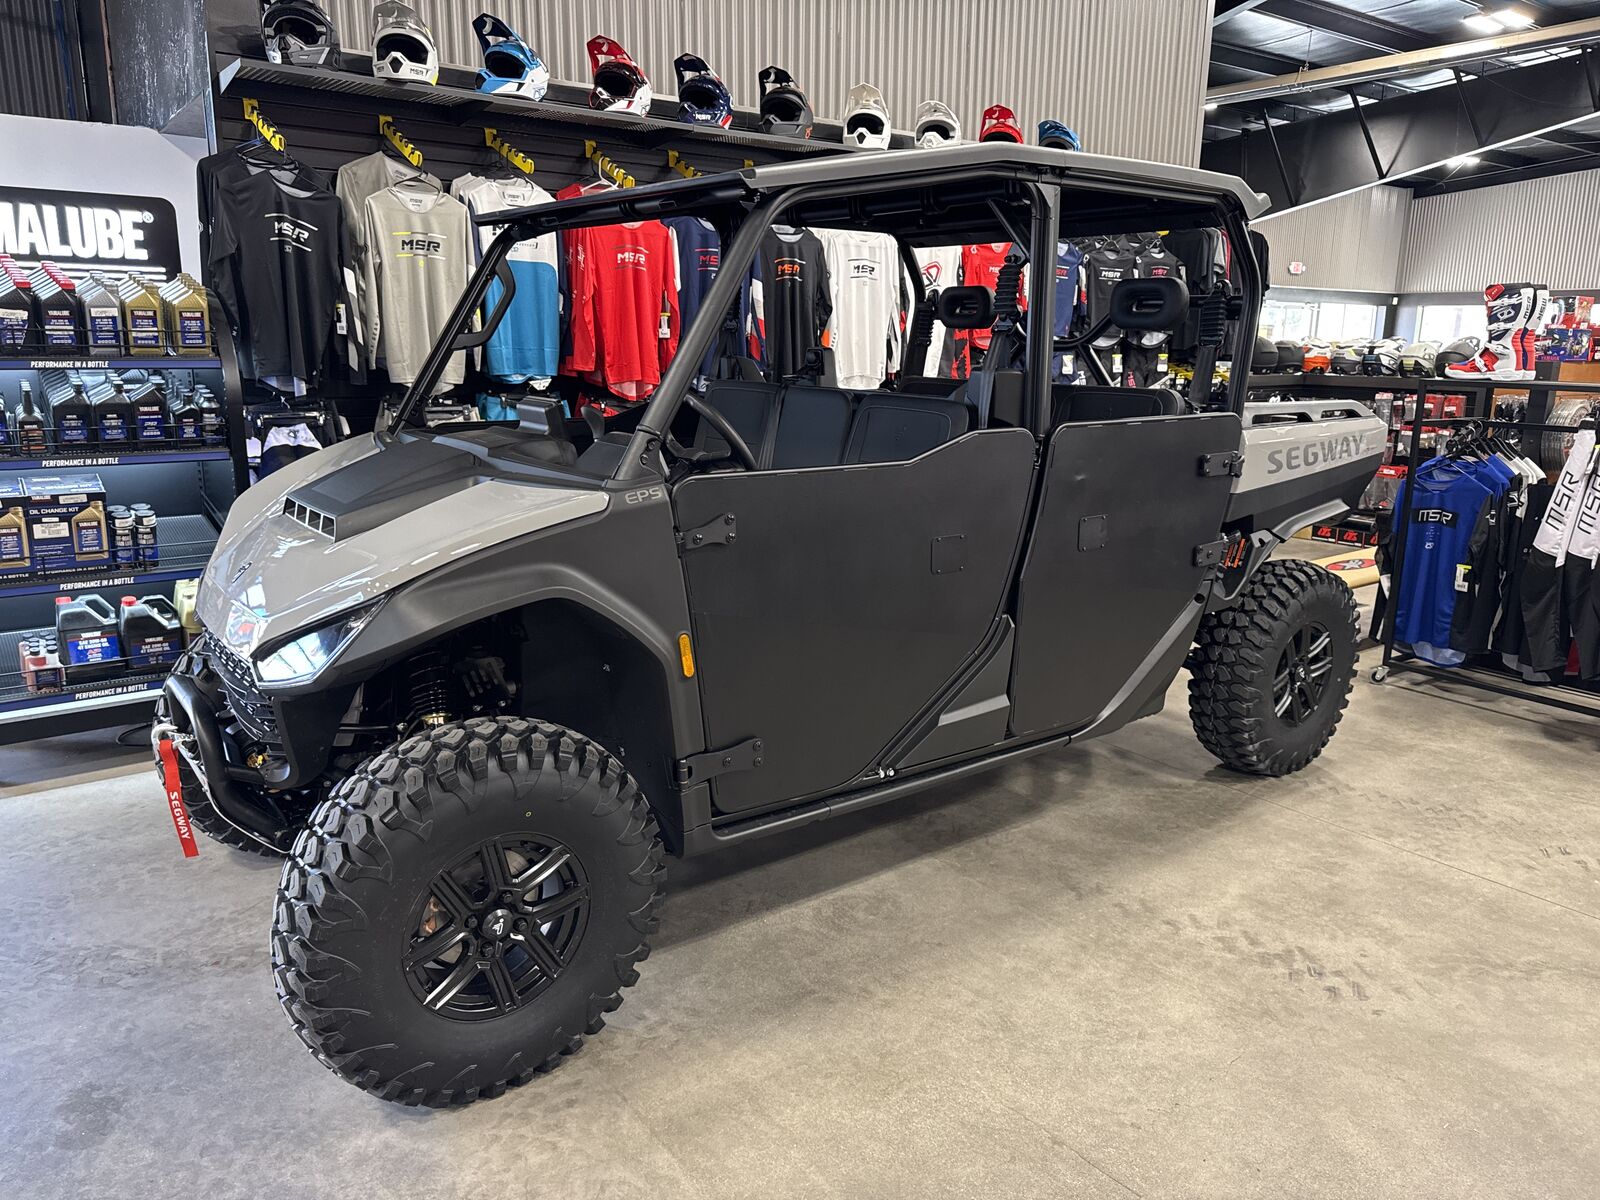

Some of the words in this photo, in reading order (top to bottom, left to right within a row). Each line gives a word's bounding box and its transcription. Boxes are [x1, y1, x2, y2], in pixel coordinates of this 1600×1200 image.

[410, 68, 424, 76] MSR
[274, 222, 309, 242] MSR
[401, 240, 440, 252] MSR
[617, 252, 647, 265] MSR
[700, 256, 718, 264] MS
[778, 264, 800, 274] MSR
[853, 264, 875, 275] MSR
[1523, 296, 1532, 319] MSR
[1537, 298, 1547, 321] MSR
[1268, 434, 1364, 474] SEGWAY
[42, 459, 84, 467] PERFORMANCE
[625, 487, 662, 504] EPS
[1545, 471, 1579, 530] MSR
[1418, 509, 1452, 524] MSR
[60, 581, 100, 590] PERFORMANCE
[114, 577, 134, 585] BOTTLE
[75, 688, 115, 700] PERFORMANCE
[128, 684, 148, 692] BOTTLE
[170, 791, 190, 839] SEGWAY
